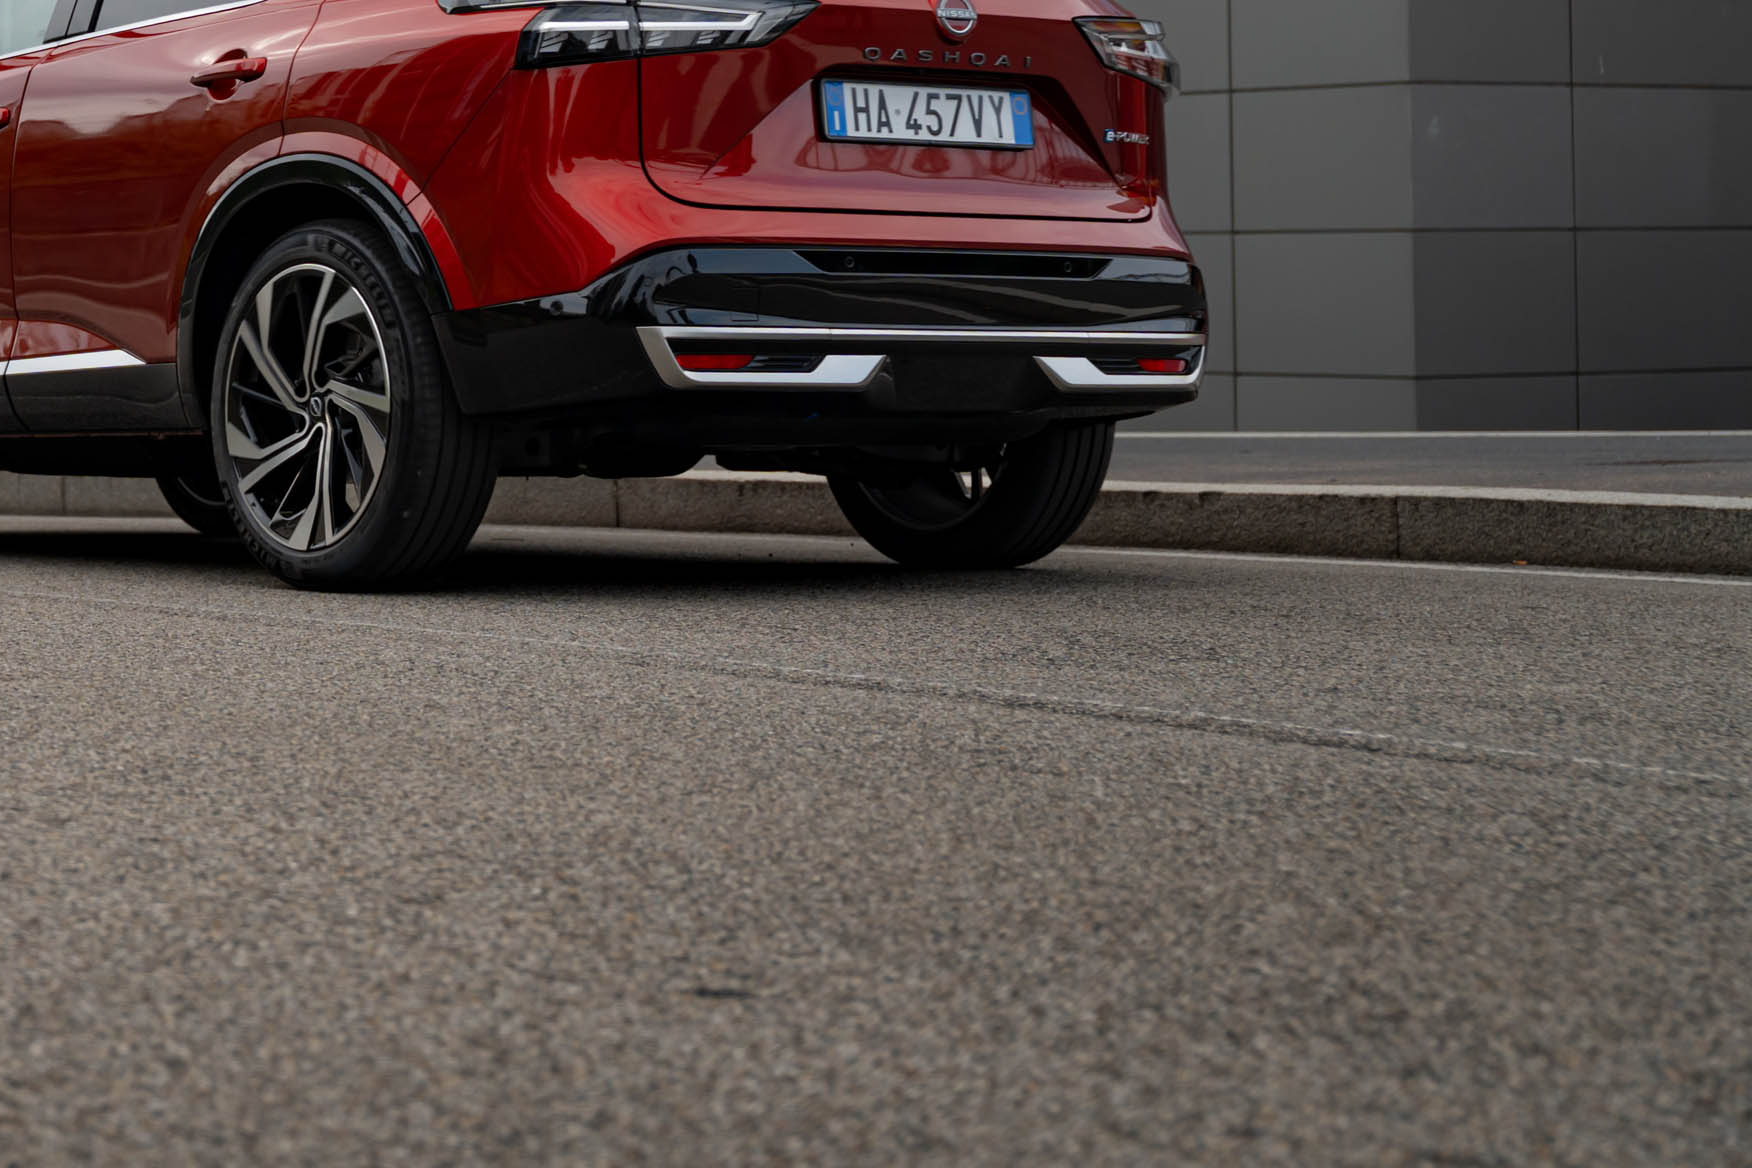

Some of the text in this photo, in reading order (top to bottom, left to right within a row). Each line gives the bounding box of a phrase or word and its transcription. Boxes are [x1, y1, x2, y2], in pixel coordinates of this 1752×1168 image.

[863, 47, 1032, 68] QASHQAI
[851, 86, 1004, 139] HA 457VY
